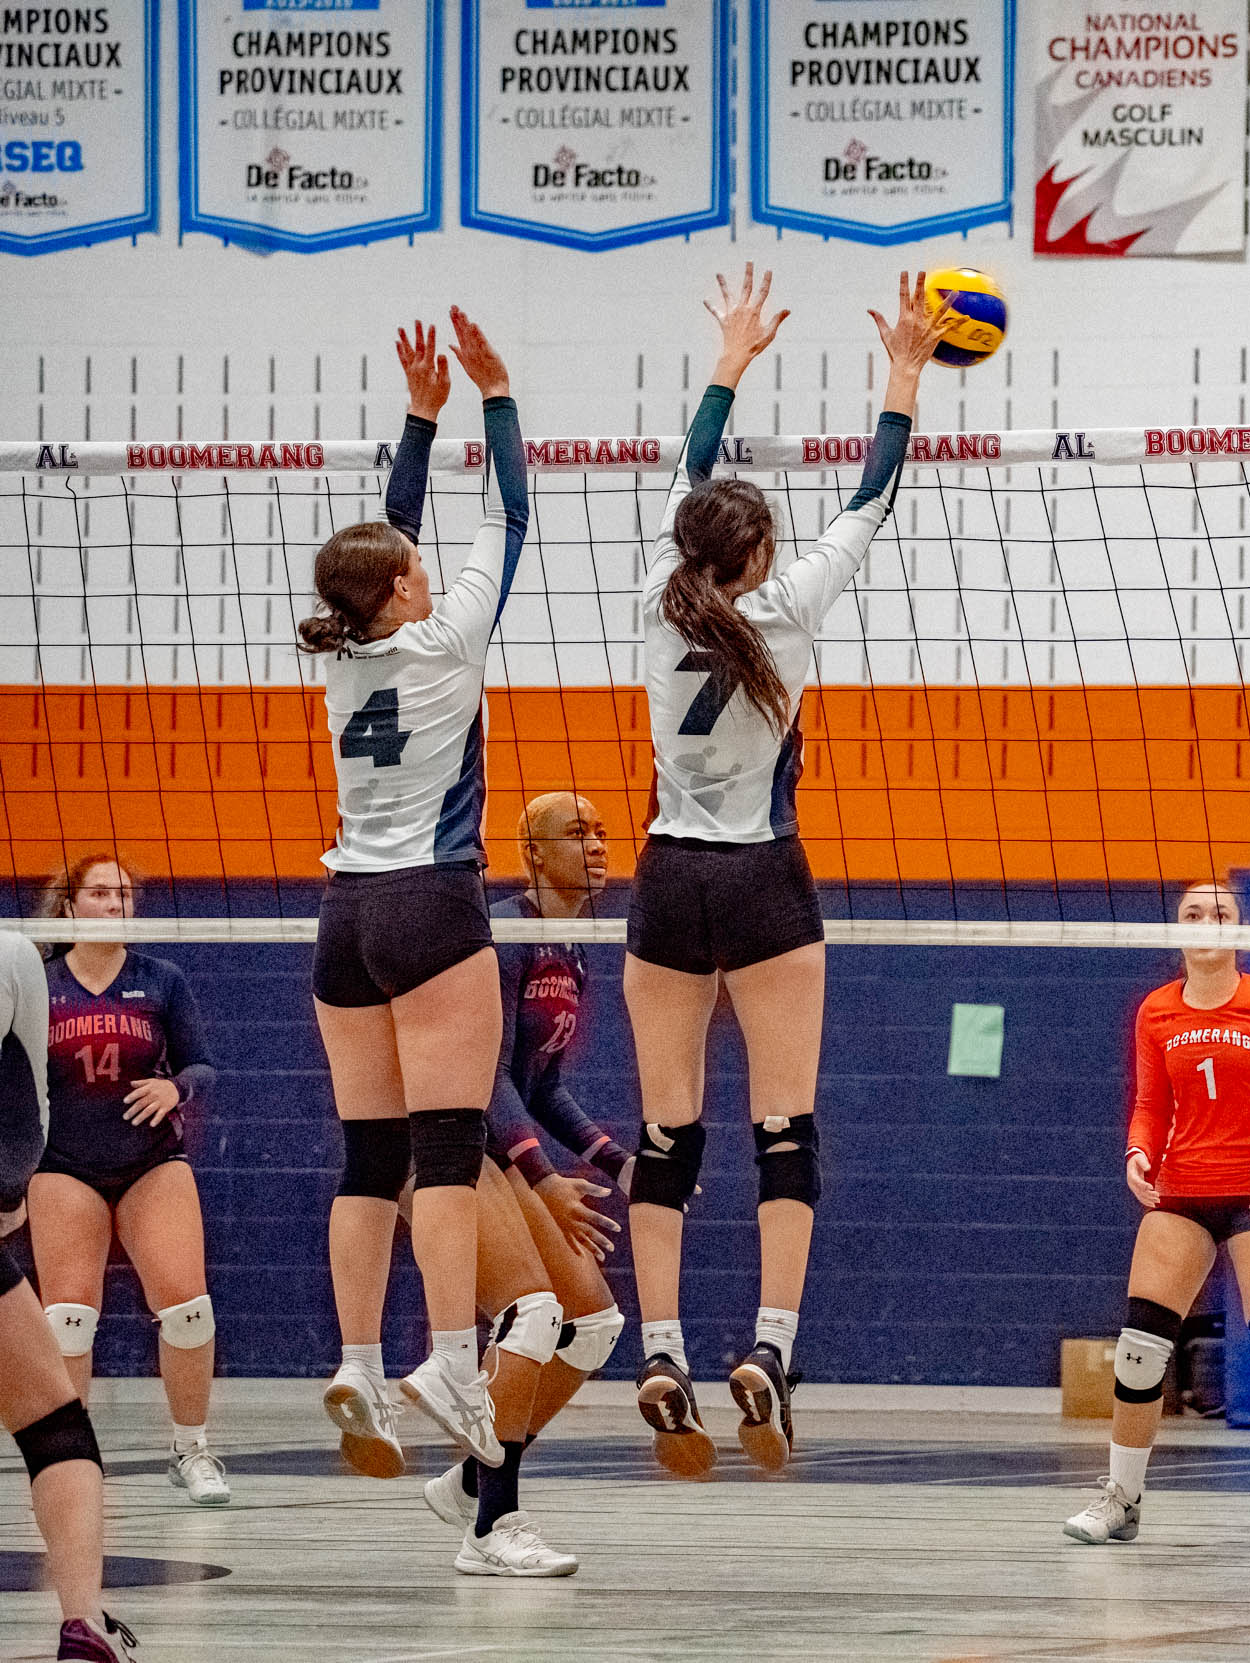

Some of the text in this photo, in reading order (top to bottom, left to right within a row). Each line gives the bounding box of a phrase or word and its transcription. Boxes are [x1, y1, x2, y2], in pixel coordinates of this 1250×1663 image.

[4, 8, 108, 34] MPIONS
[805, 18, 969, 48] CHAMPIONS
[1087, 13, 1201, 32] NATIONAL
[233, 31, 391, 57] CHAMPIONS
[515, 28, 678, 55] CHAMPIONS
[1049, 34, 1238, 61] CHAMPIONS
[0, 43, 121, 68] INCIAUX
[220, 68, 403, 95] PROVINCIAUX
[502, 65, 689, 92] PROVINCIAUX
[791, 57, 981, 86] PROVINCIAUX
[1076, 69, 1212, 88] CANADIENS
[52, 80, 107, 100] MIXTE
[0, 106, 48, 126] iveau
[234, 105, 390, 131] COLLÉGIAL MIXTE
[516, 104, 674, 128] COLLÉGIAL MIXTE
[806, 97, 968, 123] COLLÉGIAL MIXTE
[1112, 104, 1172, 123] GOLF
[1083, 128, 1203, 147] MASCULIN
[0, 140, 84, 172] SEQ
[824, 157, 856, 181] De
[248, 165, 279, 188] De
[533, 164, 566, 187] De
[36, 444, 78, 469] AL
[126, 443, 324, 469] BOOMERANG
[464, 439, 660, 467] BMERANG
[802, 433, 1001, 464] BOORANG
[1051, 432, 1095, 460] AL
[674, 651, 744, 735] 7
[339, 688, 413, 768] 4
[1166, 1028, 1250, 1052] BOOMERANG
[75, 1043, 121, 1083] 14
[1196, 1057, 1217, 1100] 1
